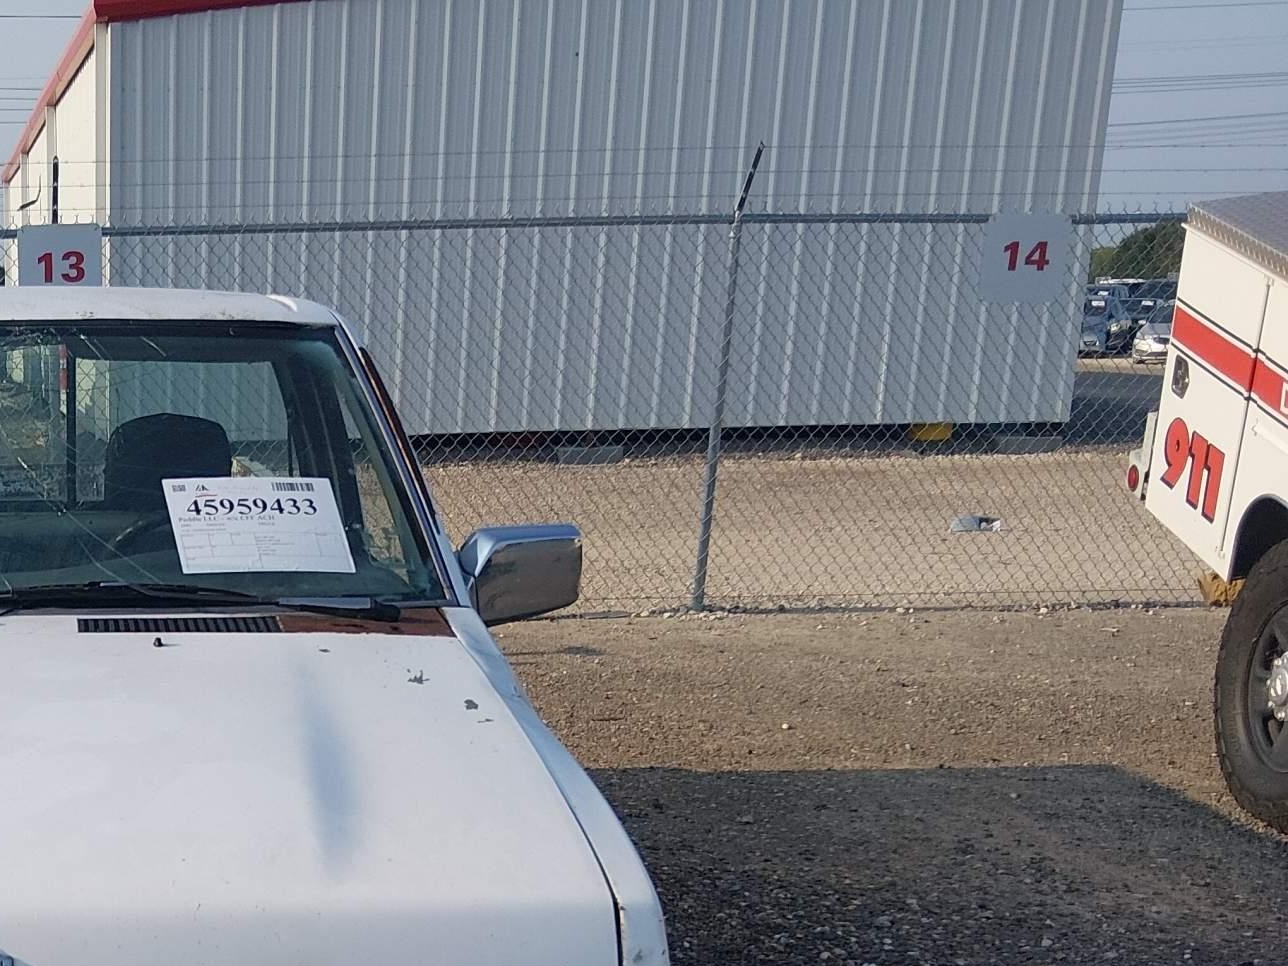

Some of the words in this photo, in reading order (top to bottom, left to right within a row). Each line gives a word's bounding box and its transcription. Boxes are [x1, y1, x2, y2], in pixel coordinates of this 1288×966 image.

[37, 250, 86, 284] 13
[1003, 240, 1050, 271] 14
[1160, 416, 1226, 525] 911
[186, 498, 318, 516] 45959433
